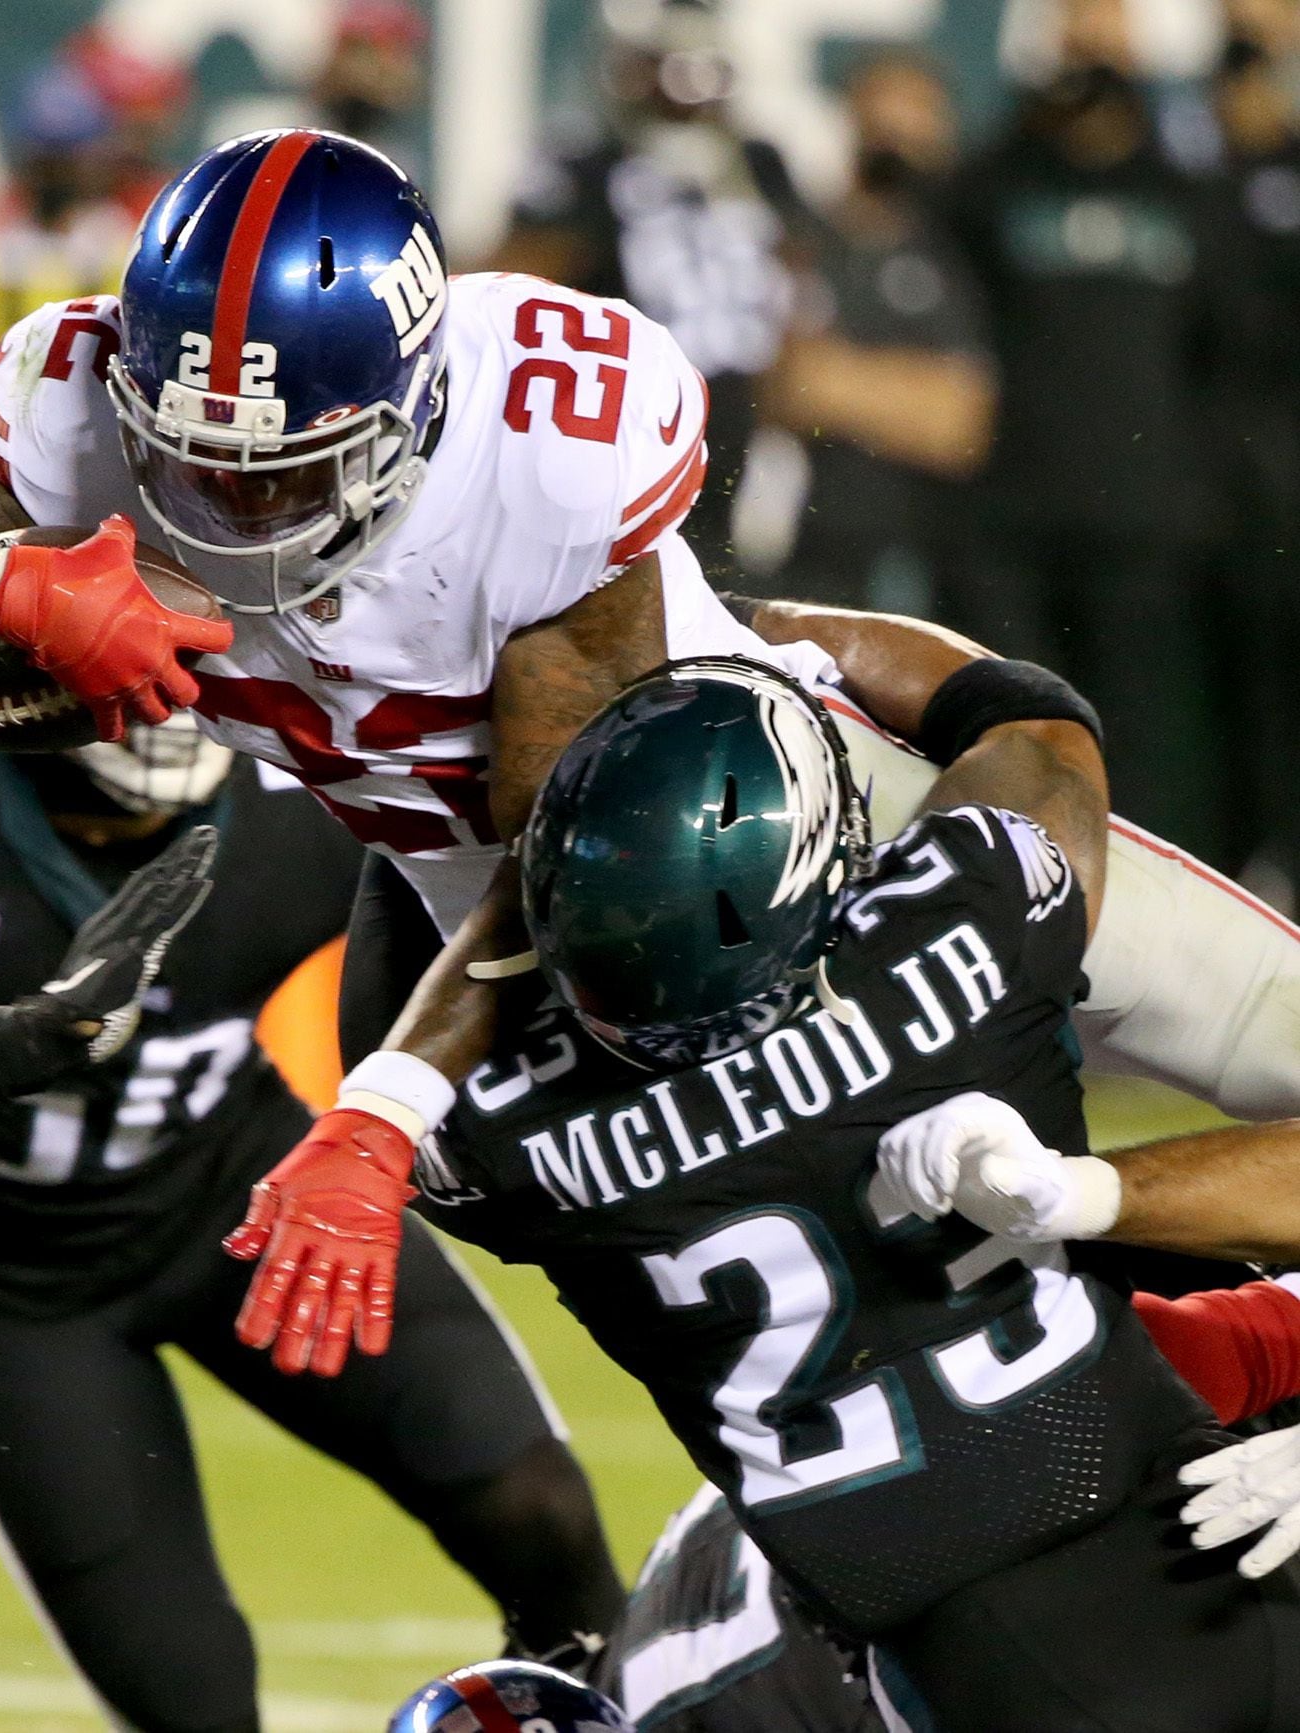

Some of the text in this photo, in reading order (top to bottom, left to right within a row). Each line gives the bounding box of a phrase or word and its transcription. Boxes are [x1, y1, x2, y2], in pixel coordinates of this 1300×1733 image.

[178, 331, 277, 398] 22
[504, 298, 630, 445] 22
[892, 923, 1007, 1056] JR
